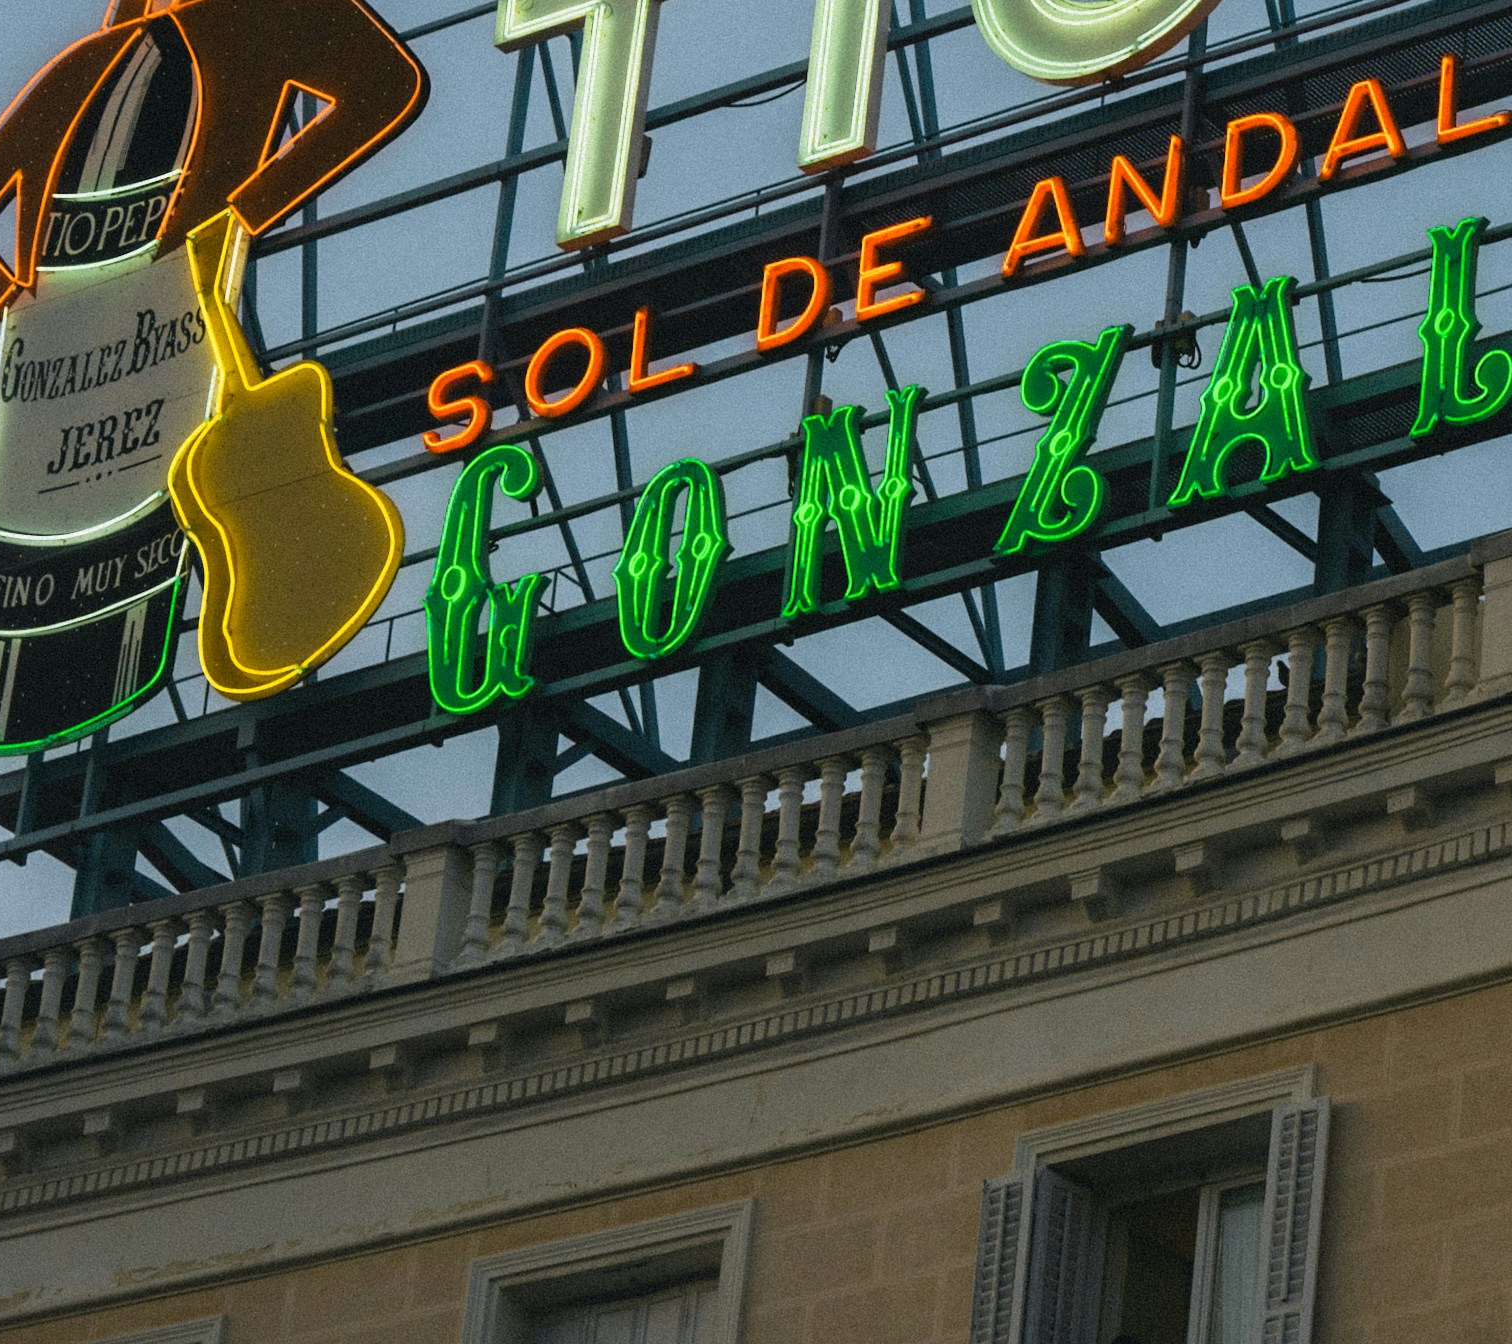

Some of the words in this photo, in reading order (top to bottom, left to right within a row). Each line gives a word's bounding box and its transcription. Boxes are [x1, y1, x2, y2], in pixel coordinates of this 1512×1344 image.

[422, 307, 699, 454] SOL
[757, 215, 934, 353] DE
[0, 338, 128, 403] GONZALEZ
[47, 399, 165, 475] JEREZ
[70, 554, 128, 600] MUY
